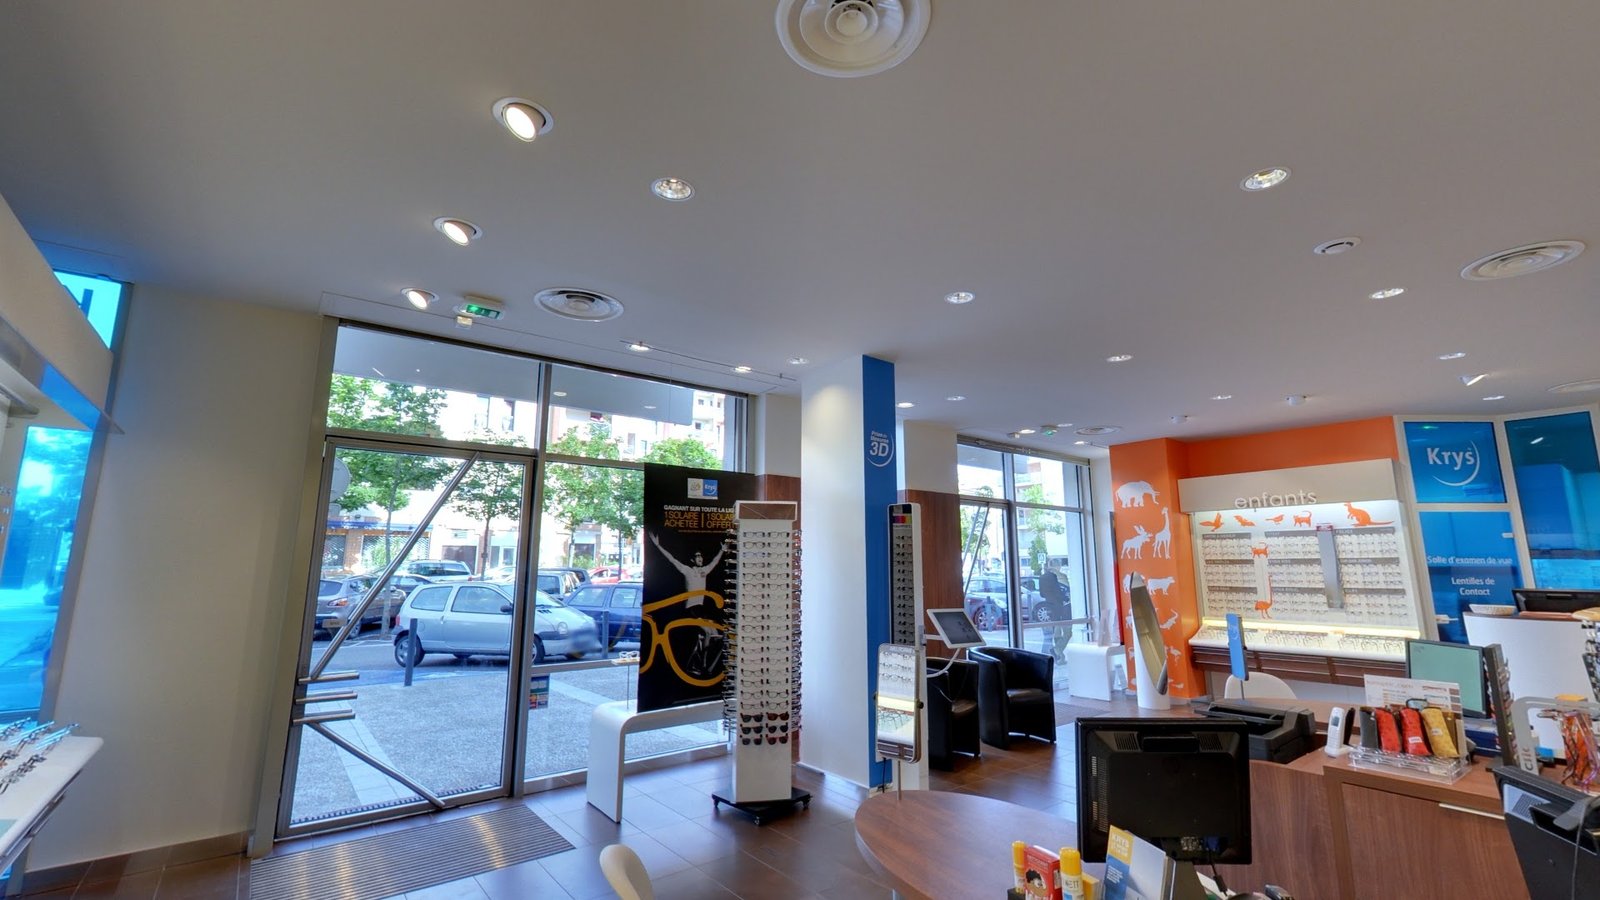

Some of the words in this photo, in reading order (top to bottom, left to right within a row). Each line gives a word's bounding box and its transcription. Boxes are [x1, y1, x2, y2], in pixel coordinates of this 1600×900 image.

[870, 441, 889, 457] 3D
[1426, 447, 1475, 471] Krys
[1234, 489, 1317, 509] enfants
[668, 511, 699, 520] SOLAIRE
[1486, 556, 1497, 564] de
[1451, 577, 1484, 585] Lentilles
[1484, 577, 1495, 585] de
[1459, 587, 1490, 595] Contact
